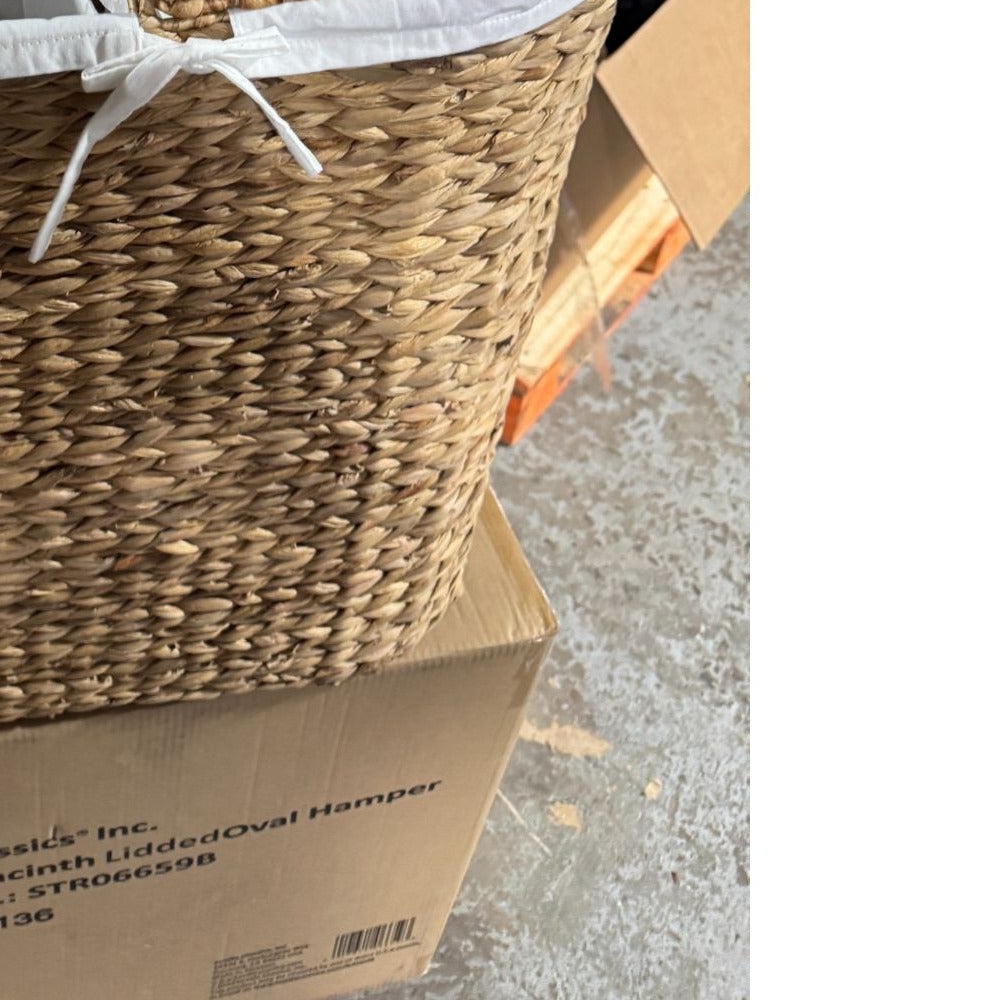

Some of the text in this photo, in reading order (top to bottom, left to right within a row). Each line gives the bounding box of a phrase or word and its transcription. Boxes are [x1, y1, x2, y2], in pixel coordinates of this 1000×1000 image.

[308, 780, 442, 819] Hamper
[97, 821, 159, 840] Inc.
[28, 852, 217, 899] STR06659B
